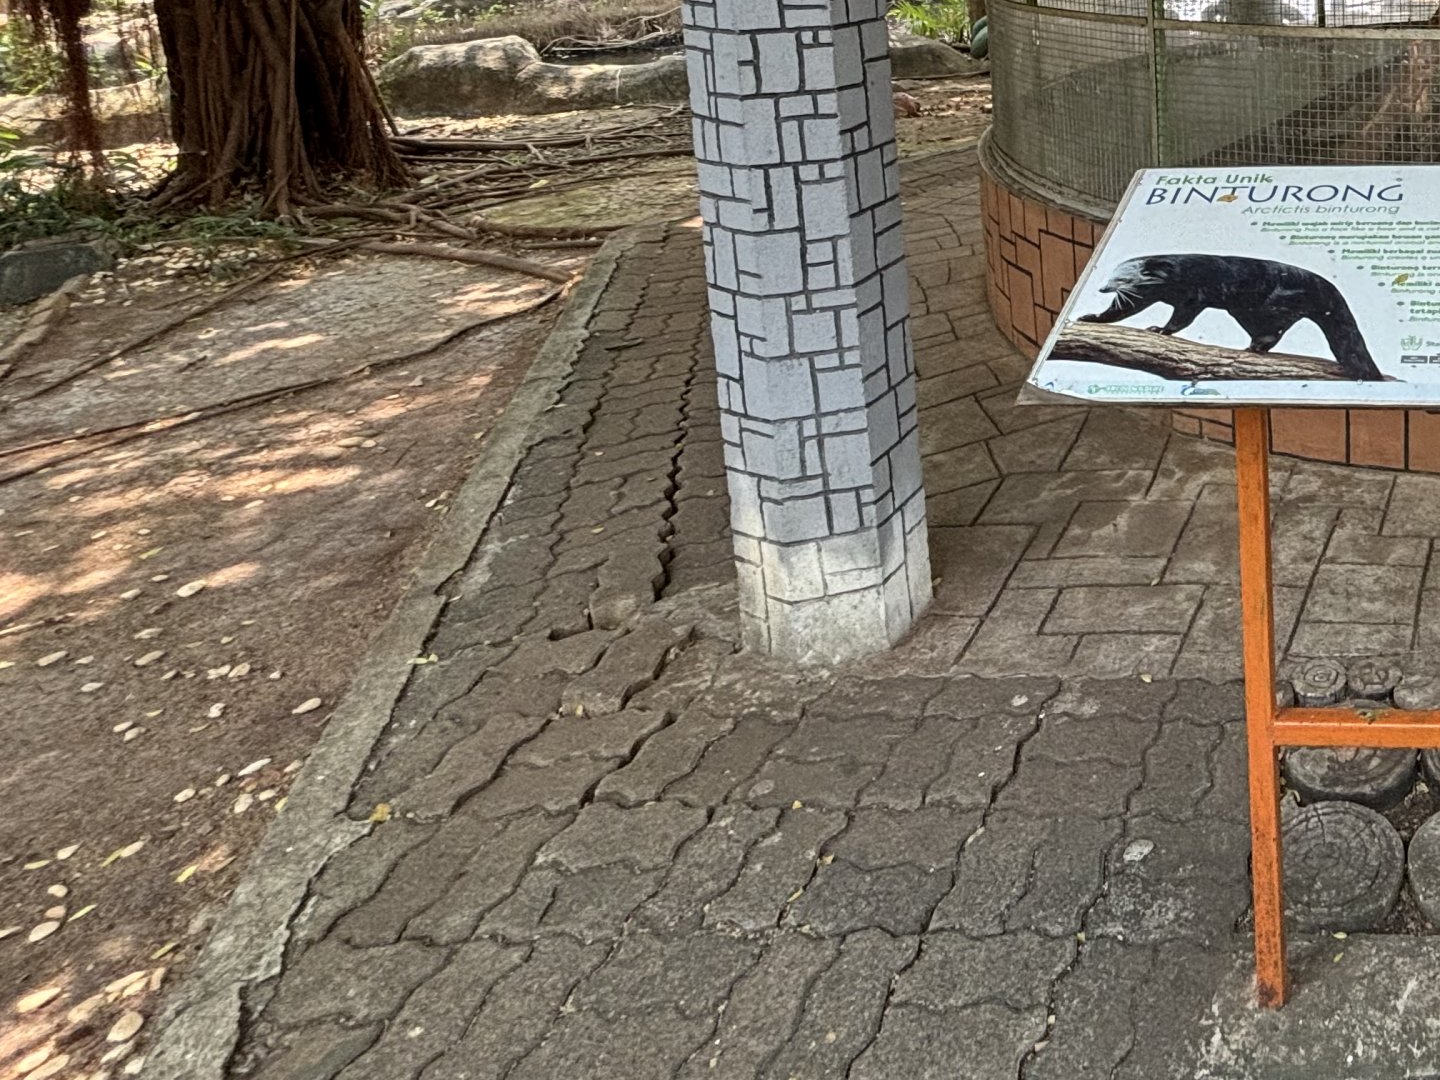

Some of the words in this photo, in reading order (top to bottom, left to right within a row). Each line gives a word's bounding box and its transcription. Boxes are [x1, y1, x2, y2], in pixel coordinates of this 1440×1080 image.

[1156, 176, 1217, 185] Fakta
[1226, 174, 1273, 184] Unik
[1146, 185, 1403, 205] BINTURONG
[1241, 206, 1310, 214] Arctictis
[1316, 205, 1400, 214] binturong
